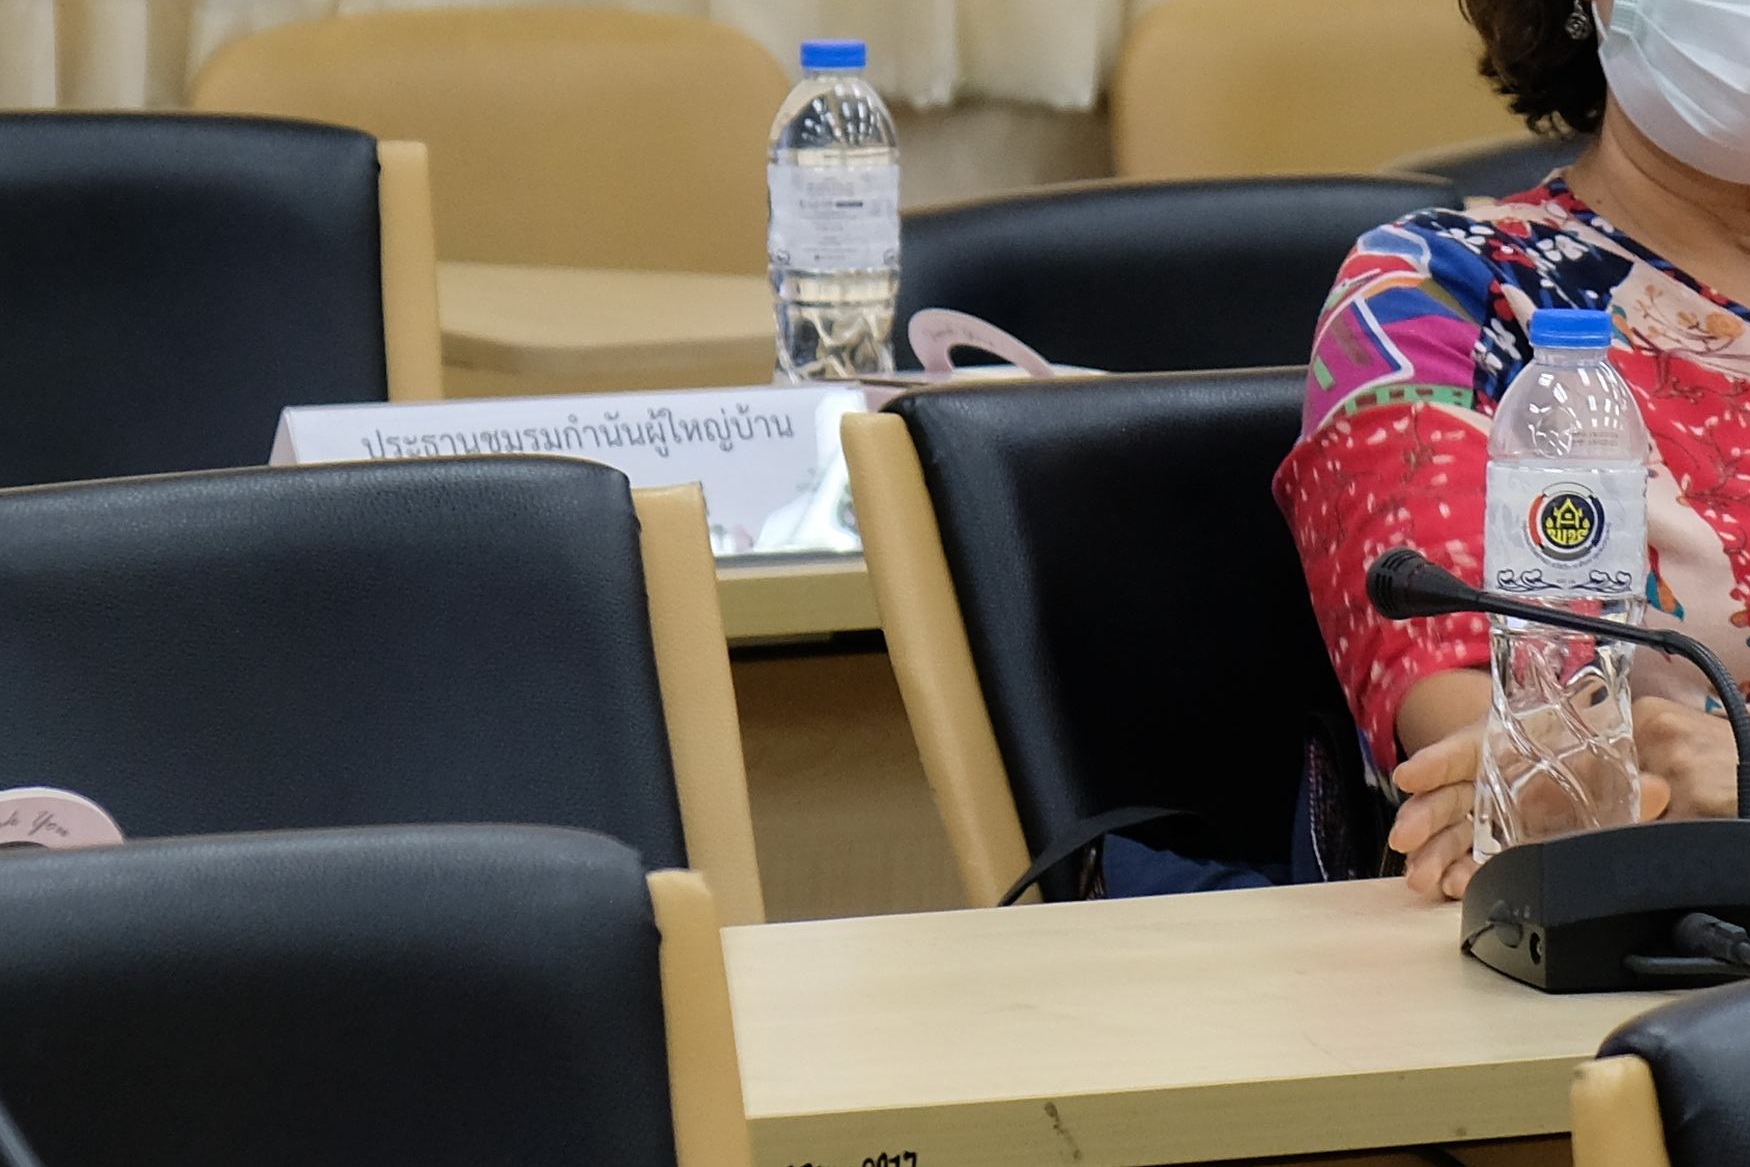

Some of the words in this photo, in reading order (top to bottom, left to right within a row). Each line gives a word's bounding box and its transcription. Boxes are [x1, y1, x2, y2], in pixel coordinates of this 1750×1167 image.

[361, 404, 796, 460] ประธานชมรมกำนันผู้ใหญ่บ้าน
